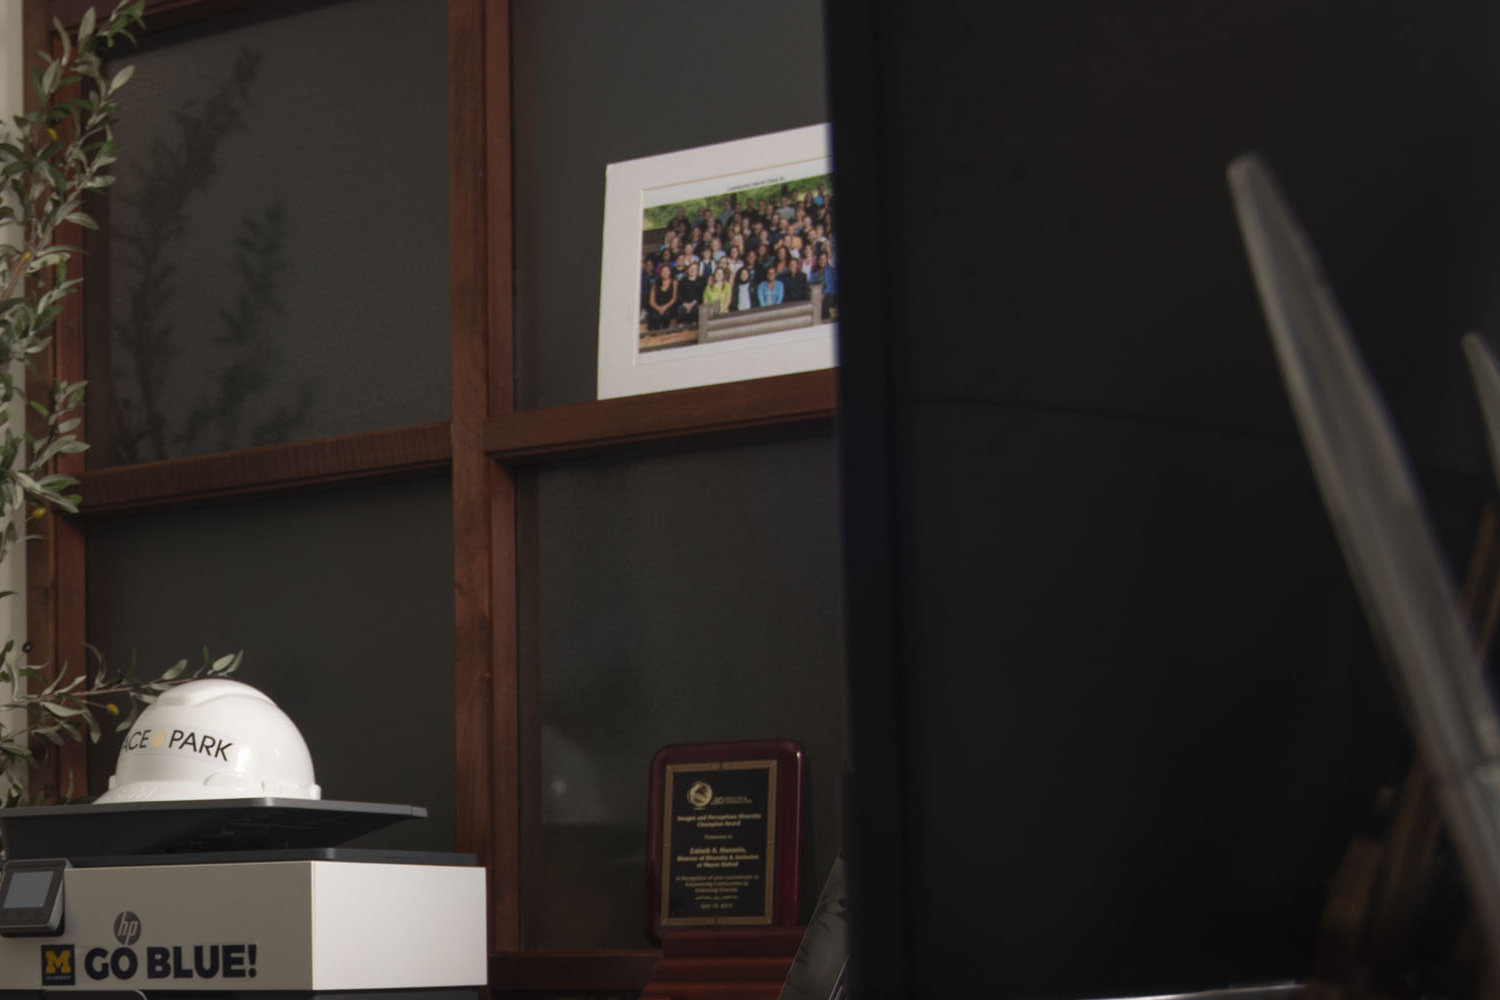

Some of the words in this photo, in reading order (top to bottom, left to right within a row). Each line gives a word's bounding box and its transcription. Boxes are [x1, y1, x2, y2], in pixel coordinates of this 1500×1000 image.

[168, 729, 233, 762] PARK
[115, 911, 141, 946] hp
[44, 949, 72, 974] M
[84, 946, 139, 981] GO
[146, 944, 257, 979] BLUE!
